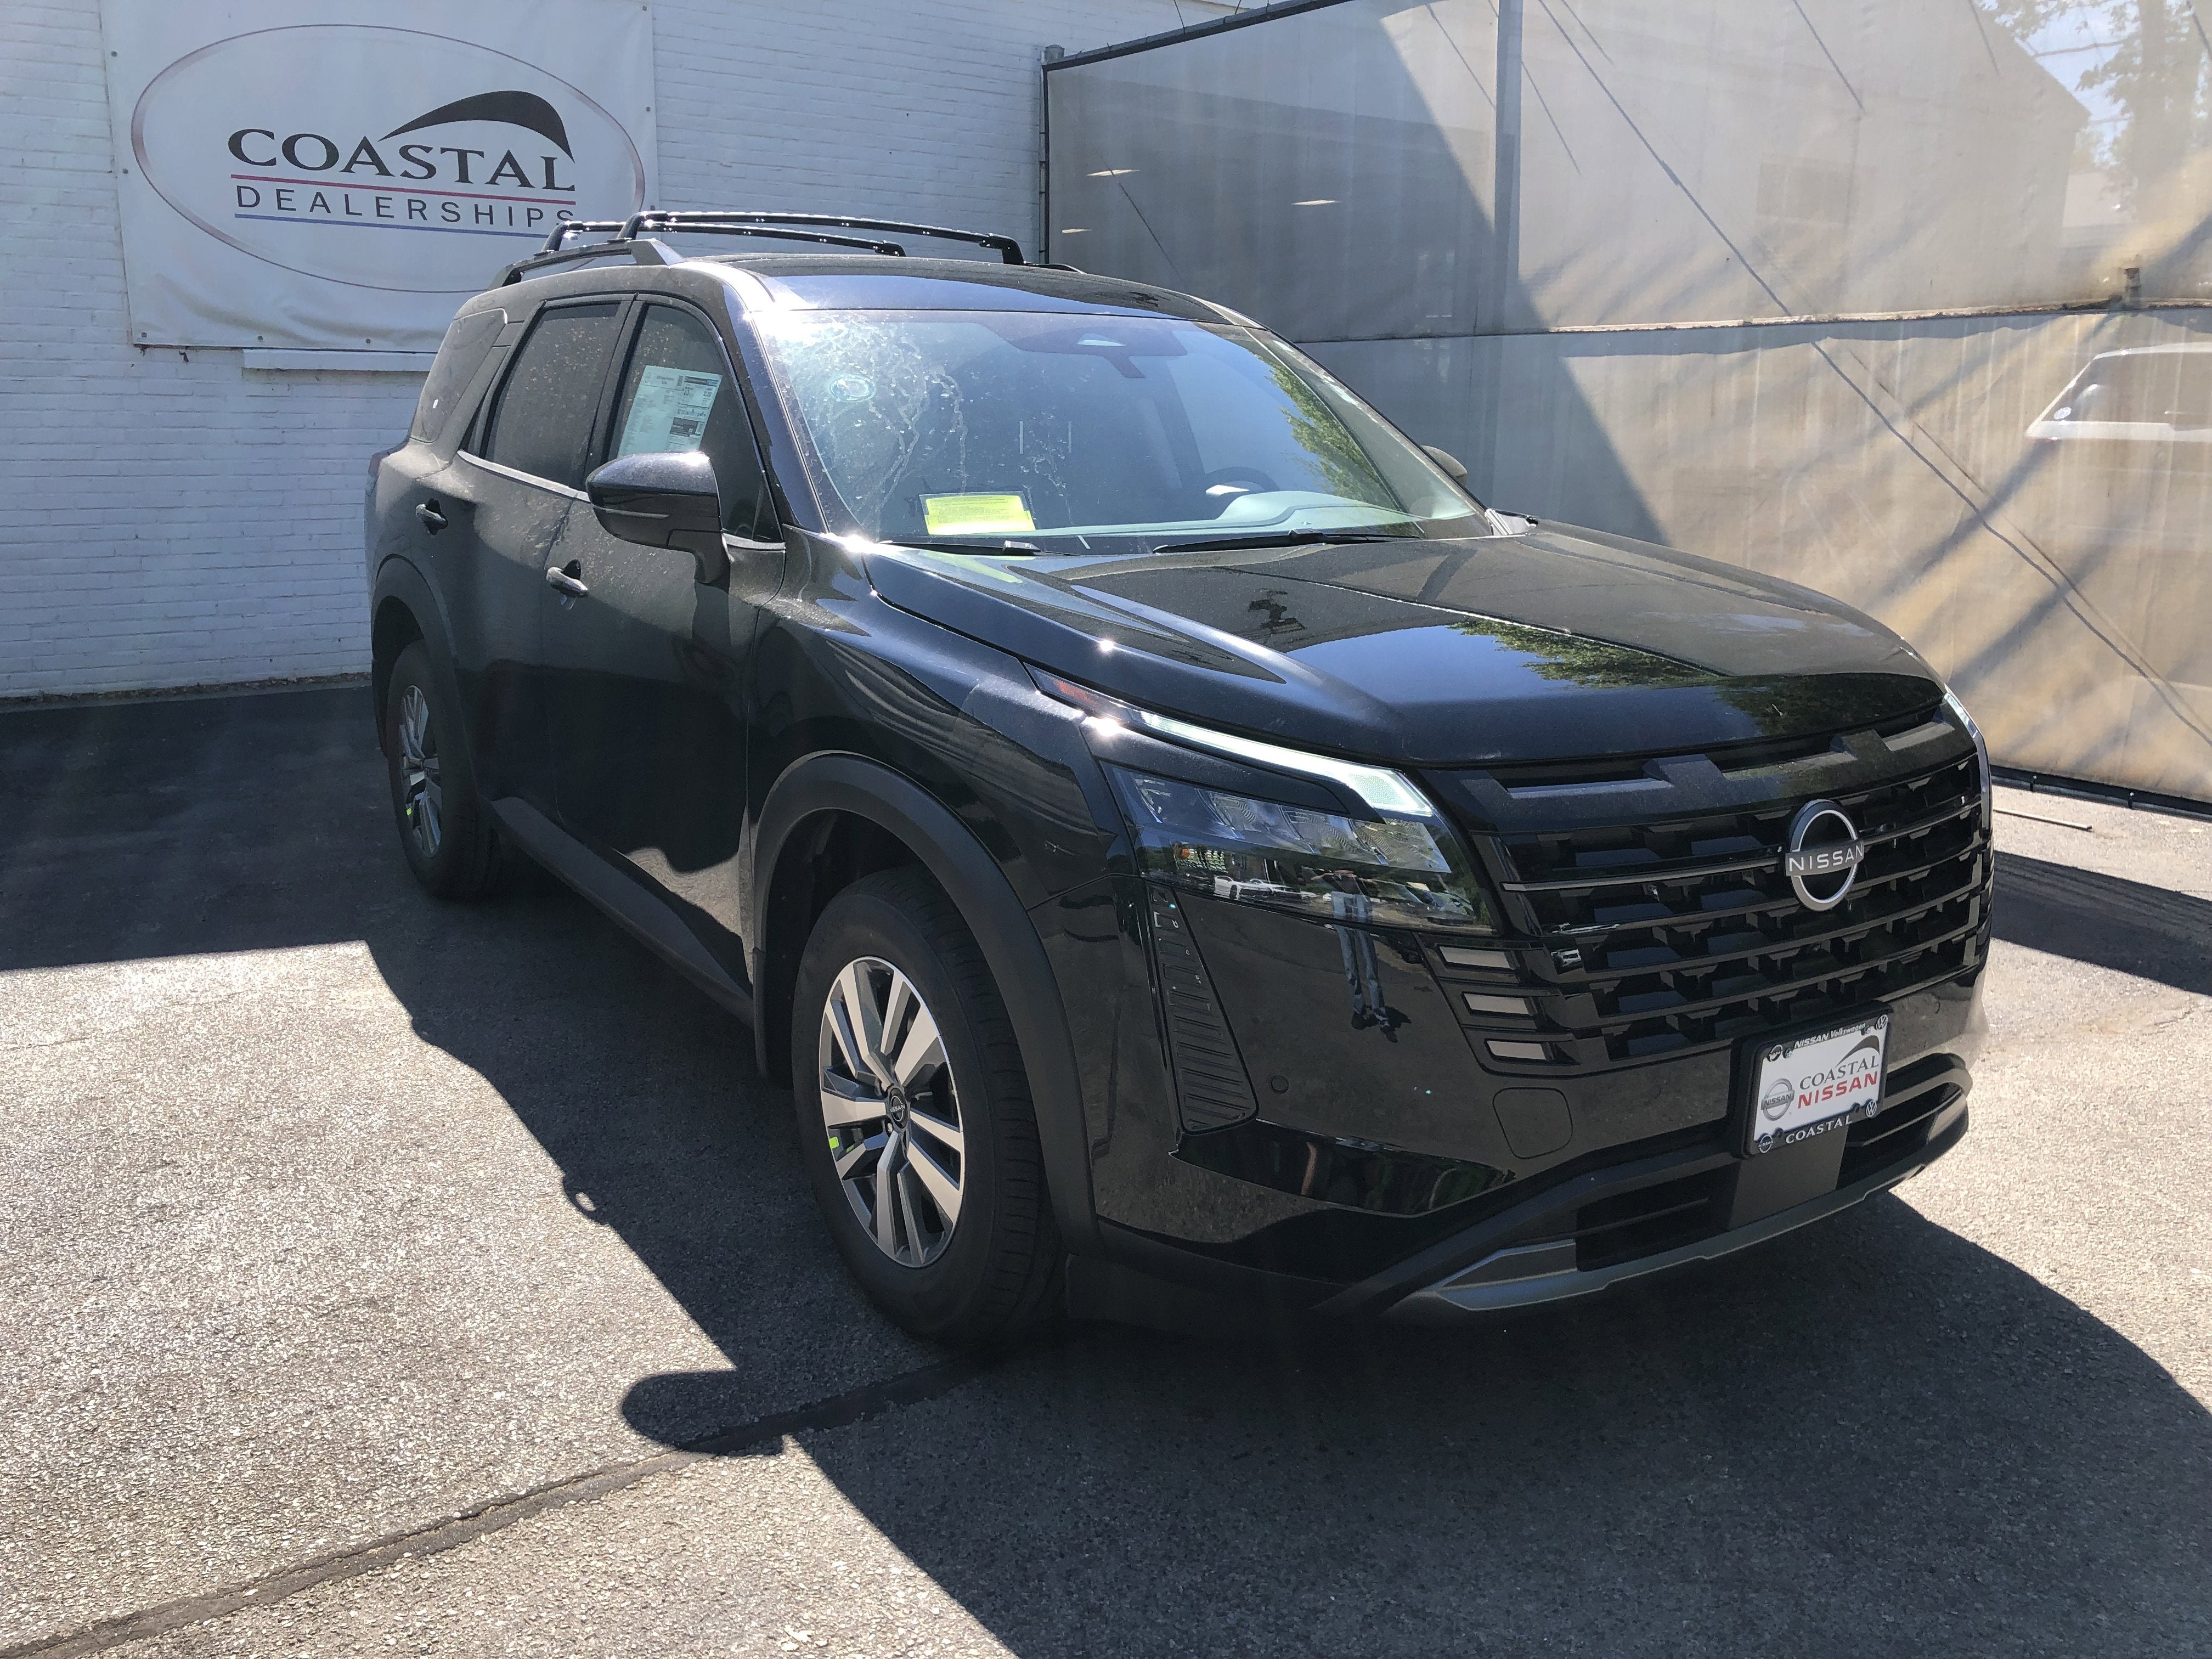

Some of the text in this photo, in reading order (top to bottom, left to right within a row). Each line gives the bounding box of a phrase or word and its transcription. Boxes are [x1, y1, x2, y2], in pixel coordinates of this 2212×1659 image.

[228, 128, 575, 191] COASTAL
[236, 185, 574, 228] DEALERSHIPS
[1789, 843, 1863, 872] NISSAN
[1794, 1033, 1829, 1049] NISSAN
[1799, 1056, 1878, 1090] COASTAL
[1764, 1093, 1791, 1106] NISSAN
[1797, 1071, 1877, 1109] NISSAN
[1786, 1115, 1852, 1144] COASTAL
